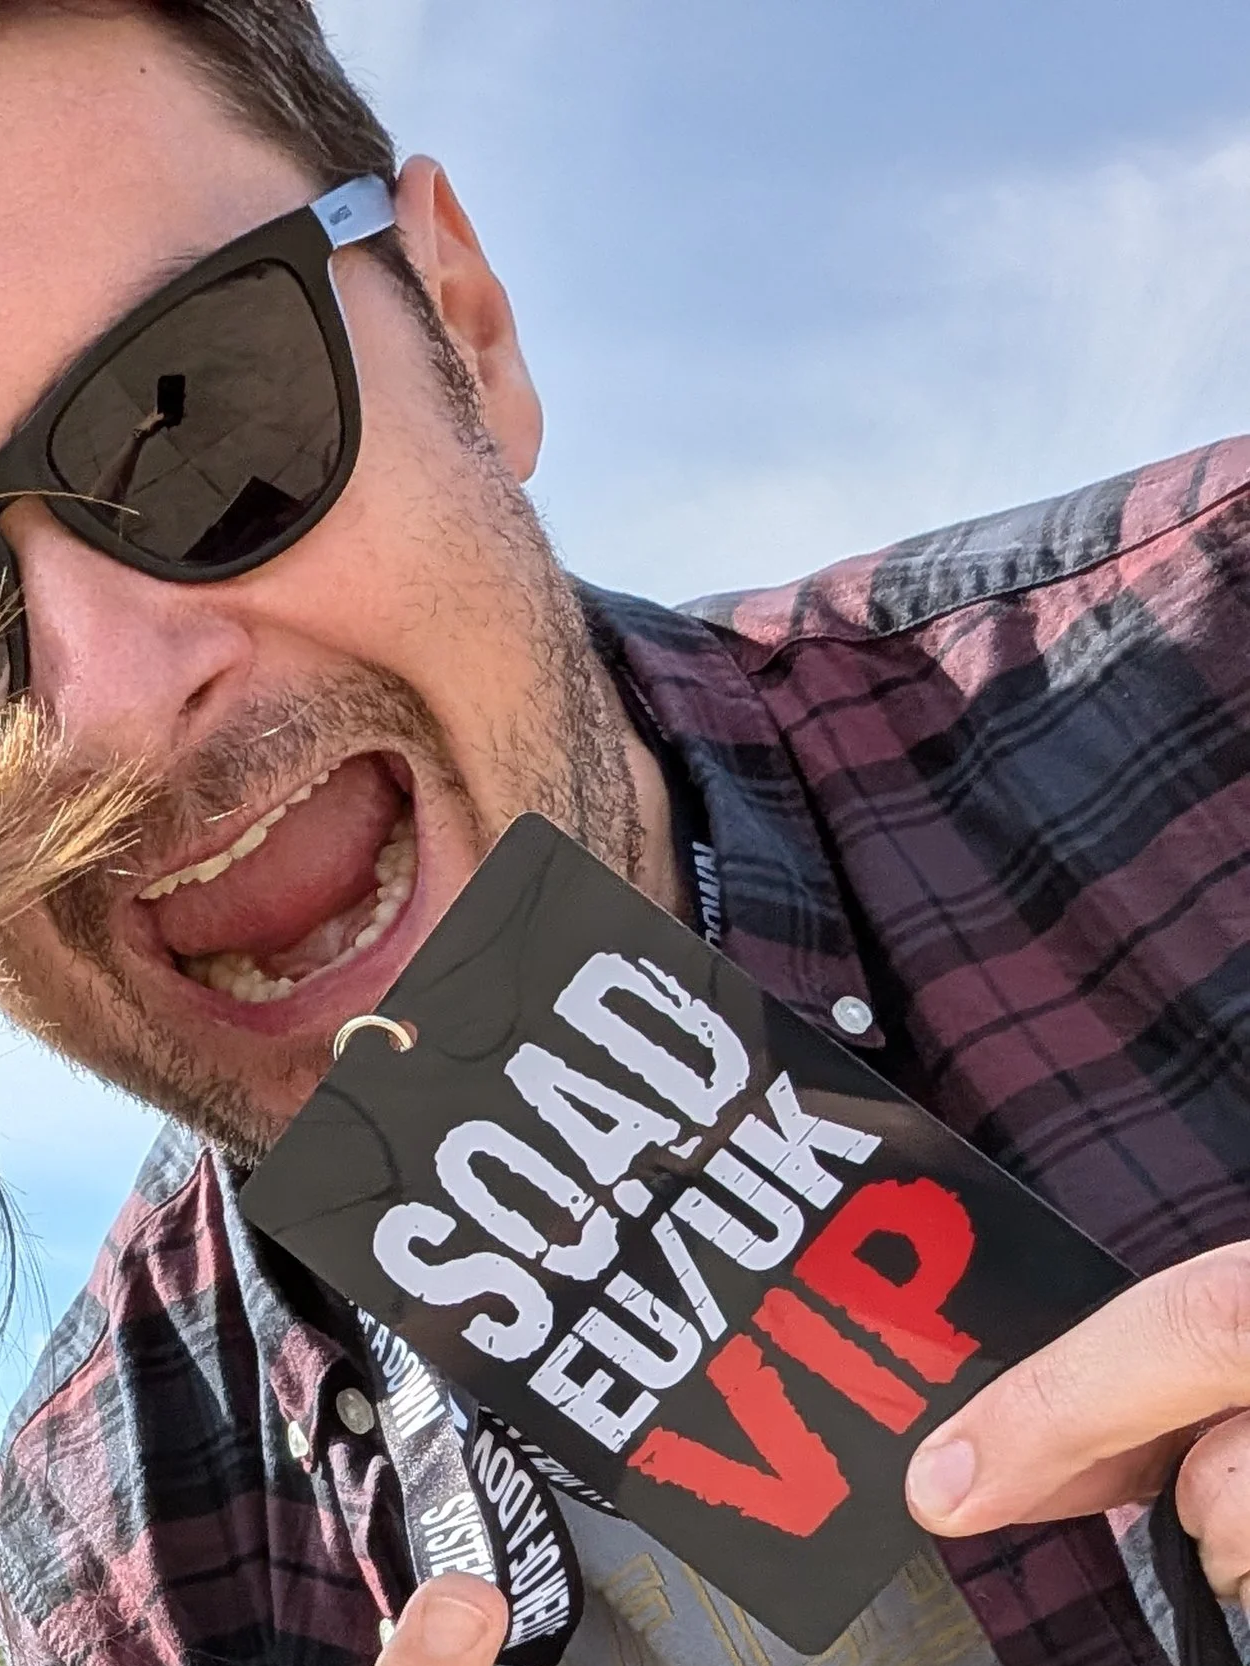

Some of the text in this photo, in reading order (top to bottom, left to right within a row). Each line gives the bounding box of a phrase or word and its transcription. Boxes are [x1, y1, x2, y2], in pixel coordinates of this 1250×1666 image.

[373, 952, 750, 1362] SOAD
[528, 1070, 882, 1453] EU/UK
[381, 1342, 448, 1441] DOWN
[627, 1177, 981, 1537] VIP
[506, 1493, 549, 1555] A
[508, 1531, 561, 1597] OF
